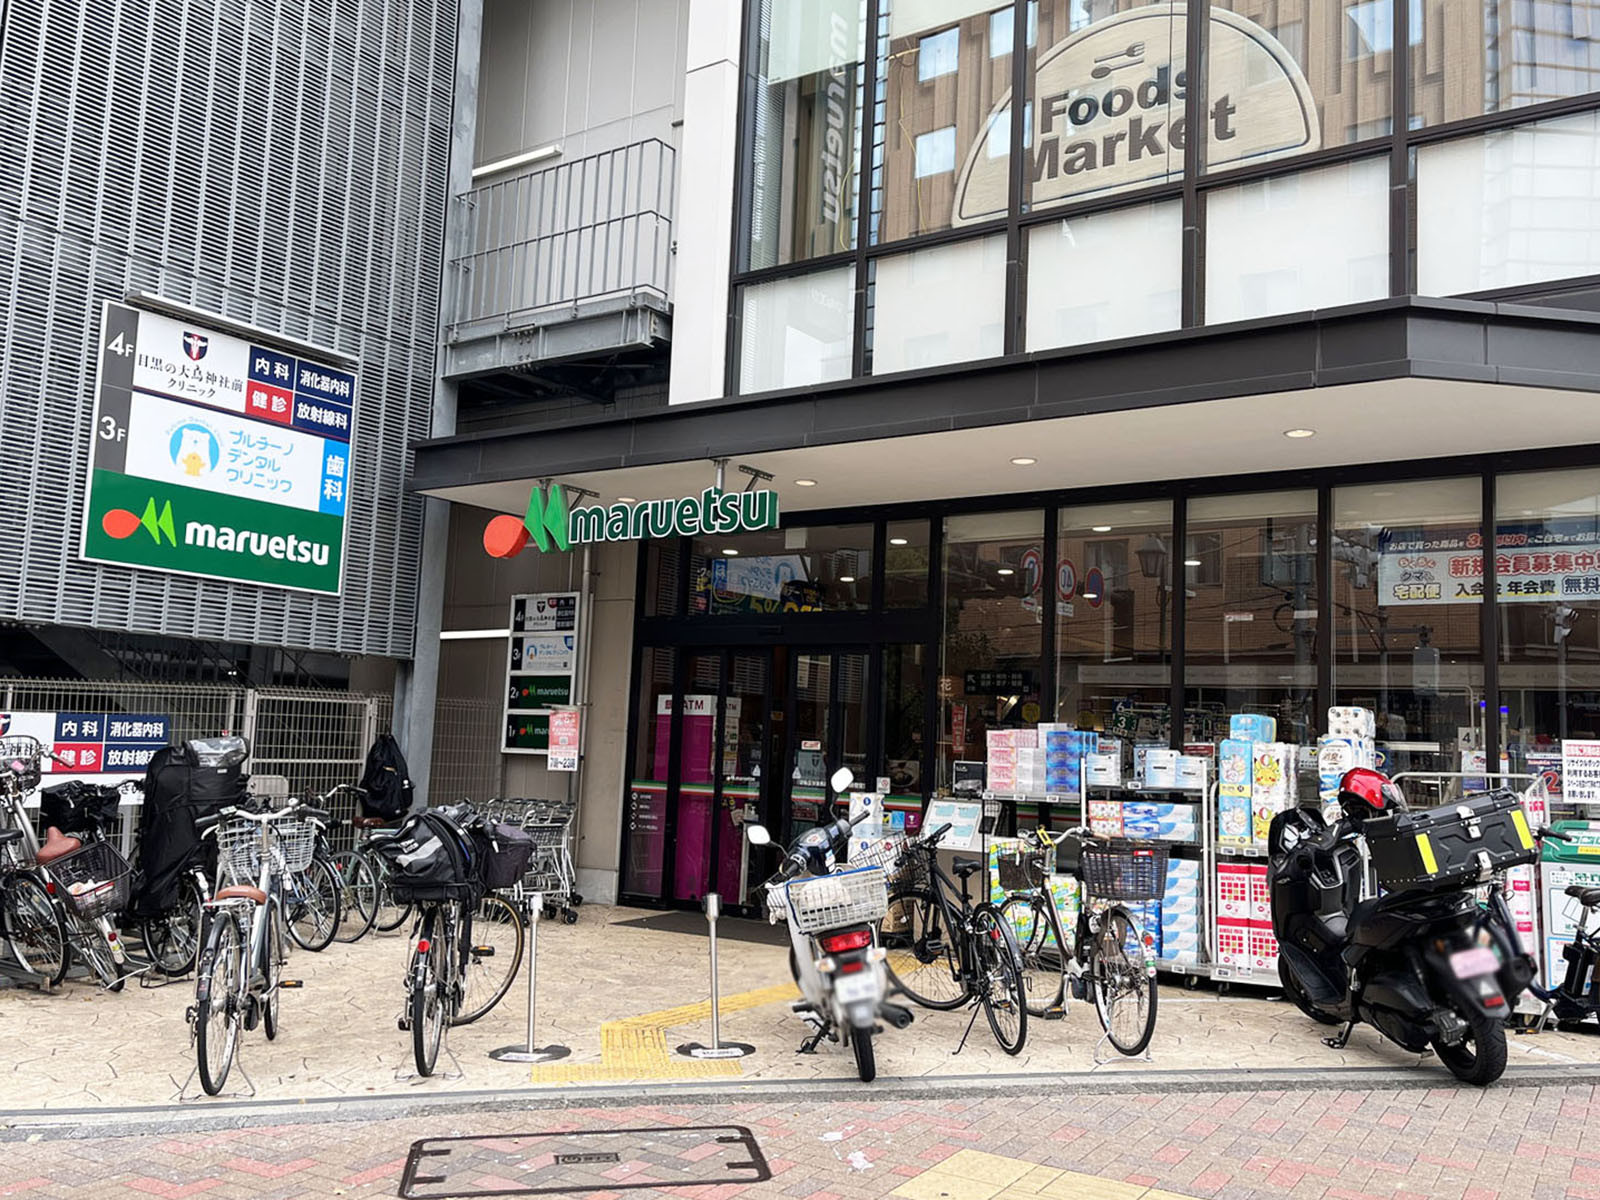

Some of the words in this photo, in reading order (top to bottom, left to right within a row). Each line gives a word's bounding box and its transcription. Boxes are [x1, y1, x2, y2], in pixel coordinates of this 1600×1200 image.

[107, 332, 134, 357] 4F
[254, 357, 290, 381] 内科
[167, 377, 216, 399] クリニック
[300, 369, 350, 398] 消化器内科
[251, 389, 287, 413] 健診
[99, 415, 126, 442] 3F
[296, 402, 348, 430] 放射線科
[227, 447, 281, 472] デンタル
[226, 467, 293, 493] クリニック
[323, 454, 346, 502] 歯科
[567, 485, 779, 545] maruetsu
[184, 521, 330, 566] maruetsu
[1393, 583, 1441, 600] 宅配便
[1507, 579, 1556, 595] 年会費
[1564, 576, 1600, 594] 無料
[510, 687, 519, 699] 2F
[536, 687, 569, 697] maruetsu
[61, 721, 99, 736] 内科
[110, 721, 164, 738] 消化器内科
